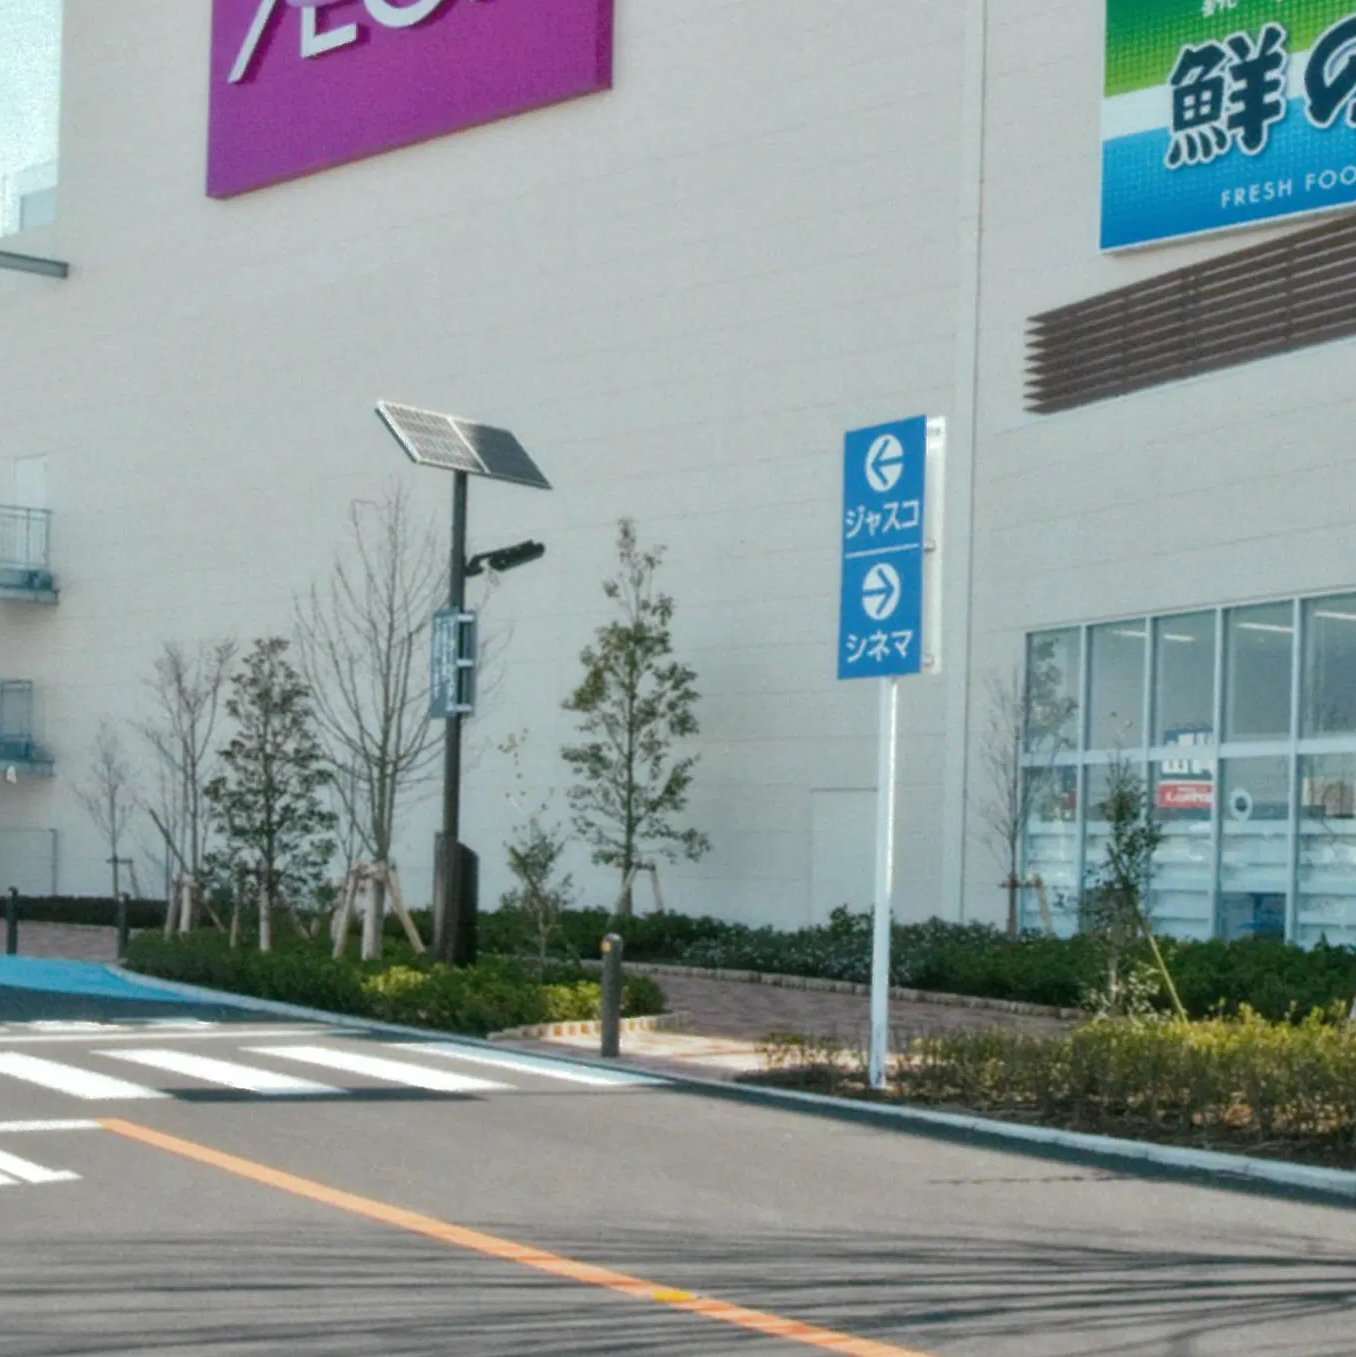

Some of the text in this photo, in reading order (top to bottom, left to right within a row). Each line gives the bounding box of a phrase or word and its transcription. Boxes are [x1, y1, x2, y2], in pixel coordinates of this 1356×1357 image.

[1220, 177, 1293, 210] FRESH
[844, 499, 920, 540] ジャスコ
[845, 628, 915, 664] シネマ
